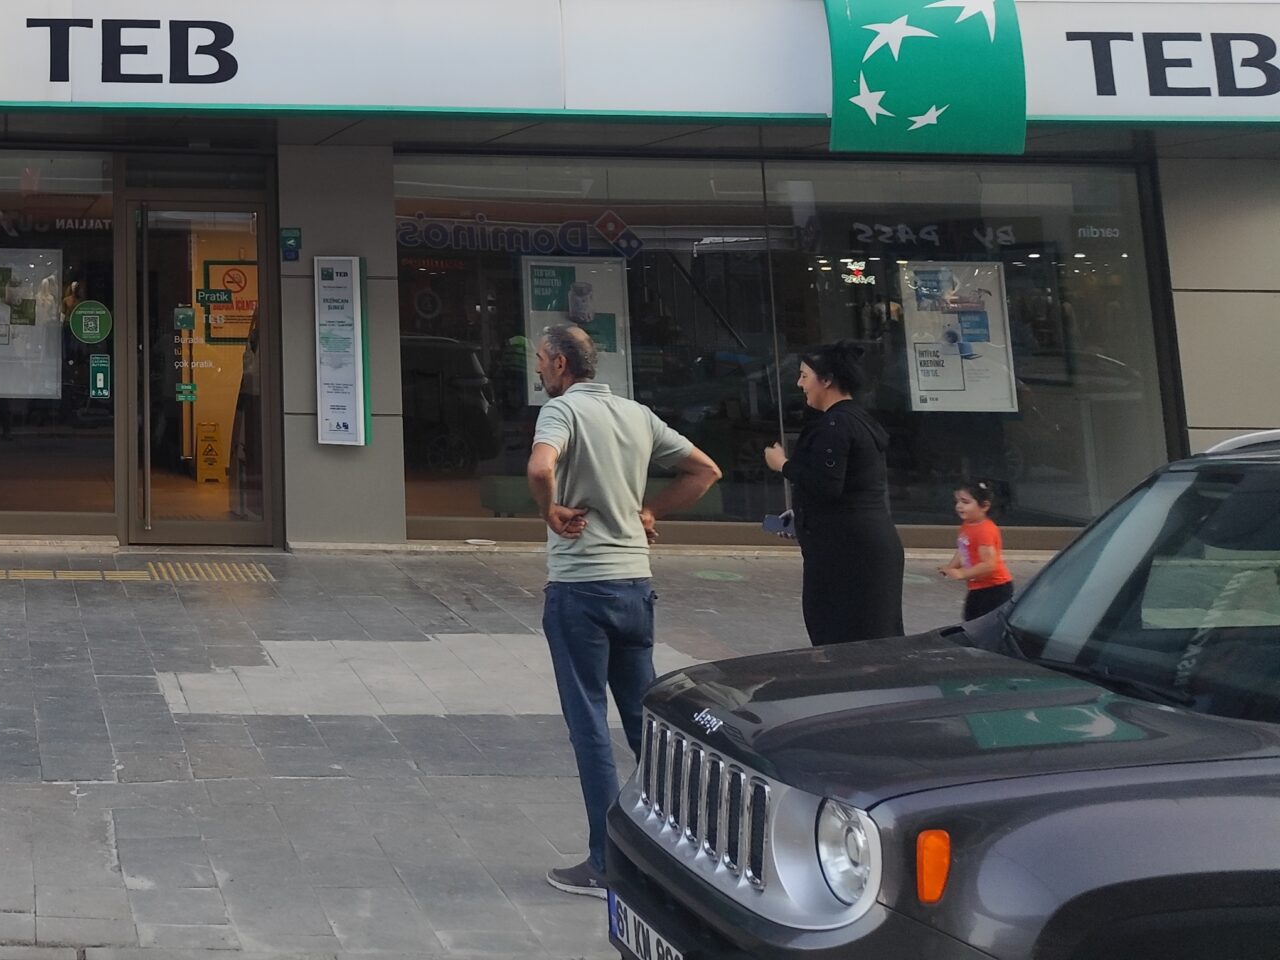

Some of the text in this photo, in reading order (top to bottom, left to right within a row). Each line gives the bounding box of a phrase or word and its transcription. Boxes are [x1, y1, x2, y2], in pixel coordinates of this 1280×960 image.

[25, 17, 239, 85] TEB
[1065, 30, 1280, 98] TEB
[198, 291, 229, 302] Pratik
